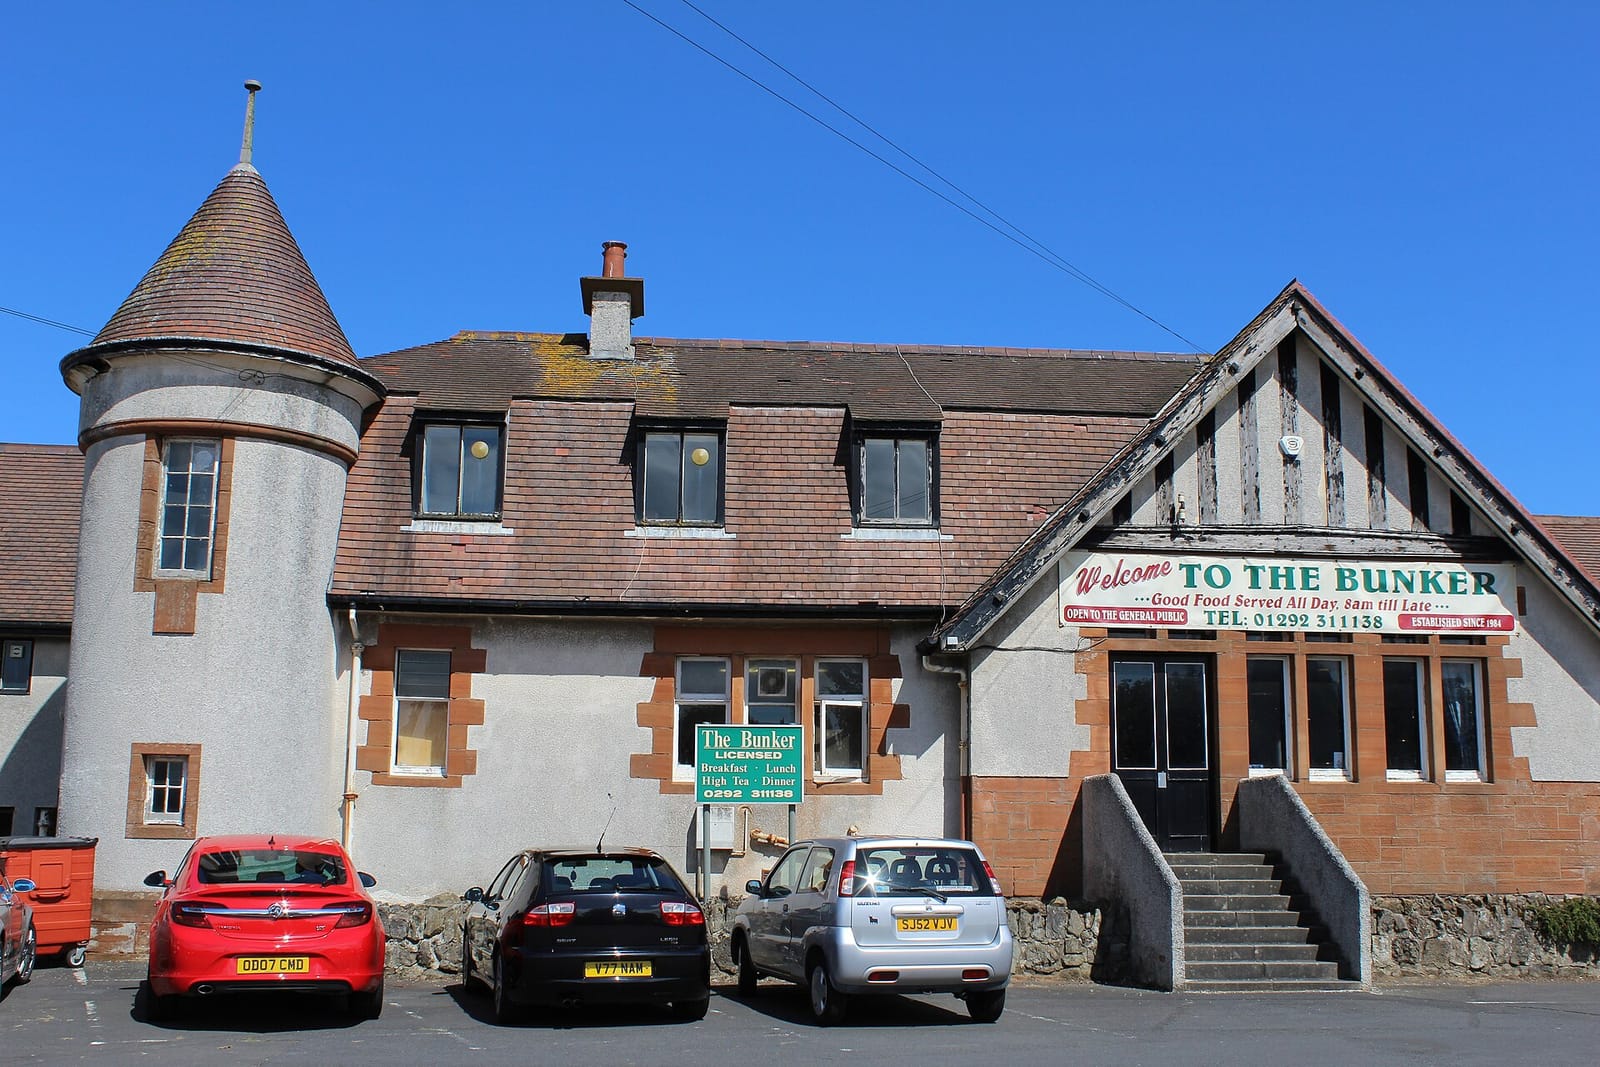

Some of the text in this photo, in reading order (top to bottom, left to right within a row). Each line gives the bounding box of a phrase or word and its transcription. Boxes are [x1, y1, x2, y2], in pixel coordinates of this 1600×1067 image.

[1076, 559, 1497, 596] Welcome TO THE BUNKER
[1193, 594, 1231, 607] Food
[1234, 594, 1283, 609] Served
[1286, 596, 1307, 609] All
[1344, 598, 1373, 610] 8am
[1377, 598, 1398, 611] till
[1067, 608, 1185, 622] OPEN TO THE GENERAL PUBLIC
[1204, 610, 1383, 629] TEL: 01292 311138
[1411, 616, 1502, 628] ESTABLISHED SINCE 1984
[702, 730, 796, 748] The Bunker
[715, 751, 782, 760] LICENSED
[701, 763, 796, 773] Breakfast Lunch
[702, 776, 796, 787] High Tea Dinner
[703, 789, 794, 798] 0292 311138
[902, 918, 953, 930] SJ52 VJV
[280, 959, 304, 970] CMD
[595, 962, 643, 974] V77 NAM
